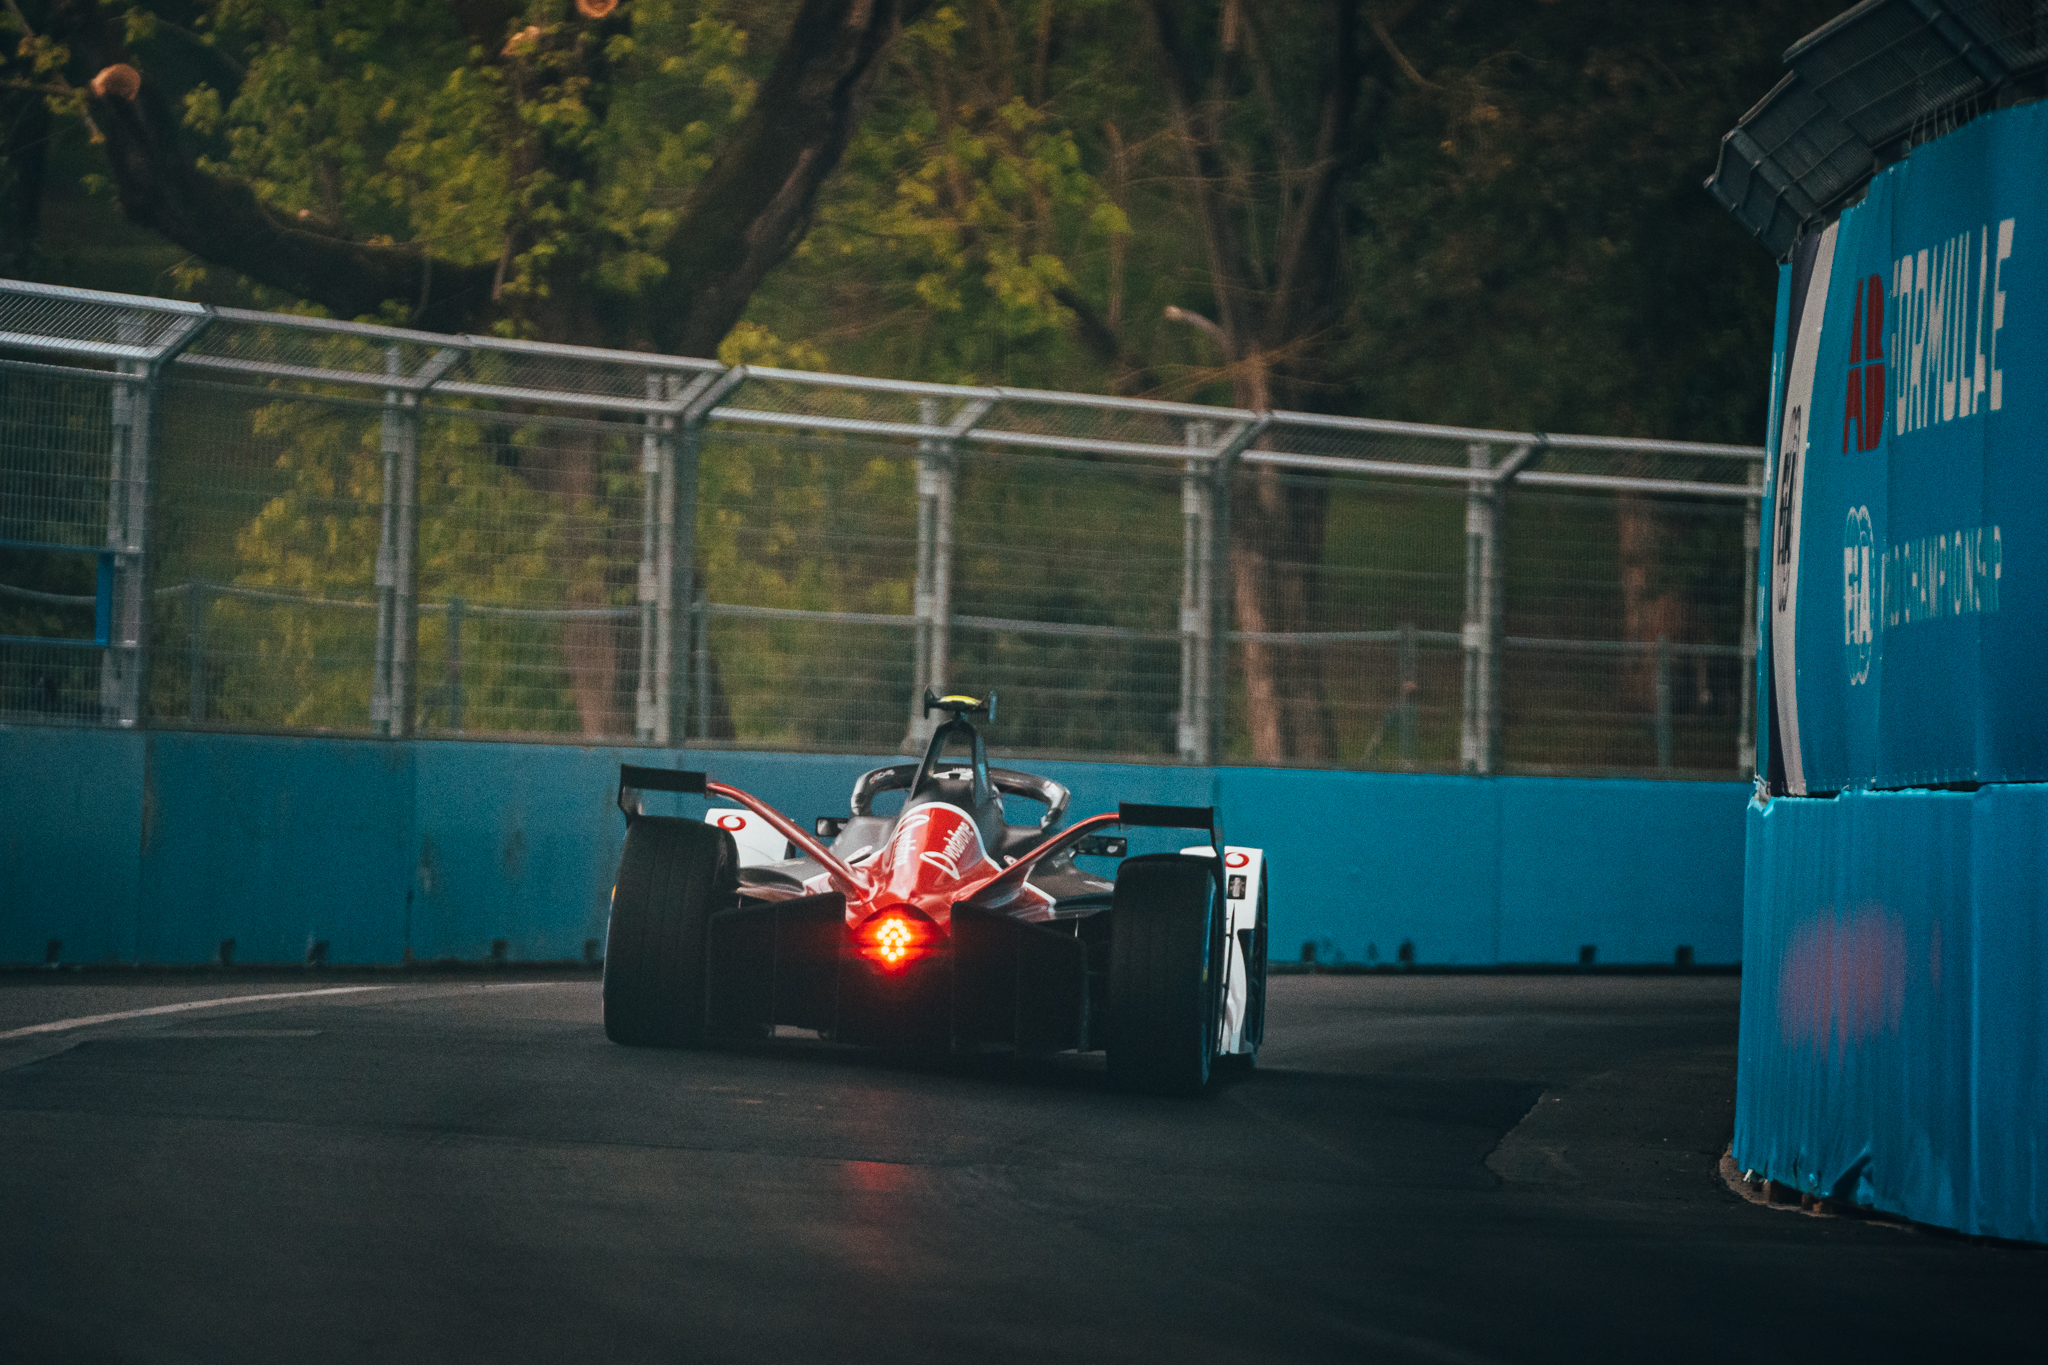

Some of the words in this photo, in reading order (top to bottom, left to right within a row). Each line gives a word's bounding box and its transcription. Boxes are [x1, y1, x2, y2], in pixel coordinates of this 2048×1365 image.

[1990, 218, 2015, 411] E
[1844, 545, 1873, 645] FIA
[942, 821, 974, 861] vodafone
